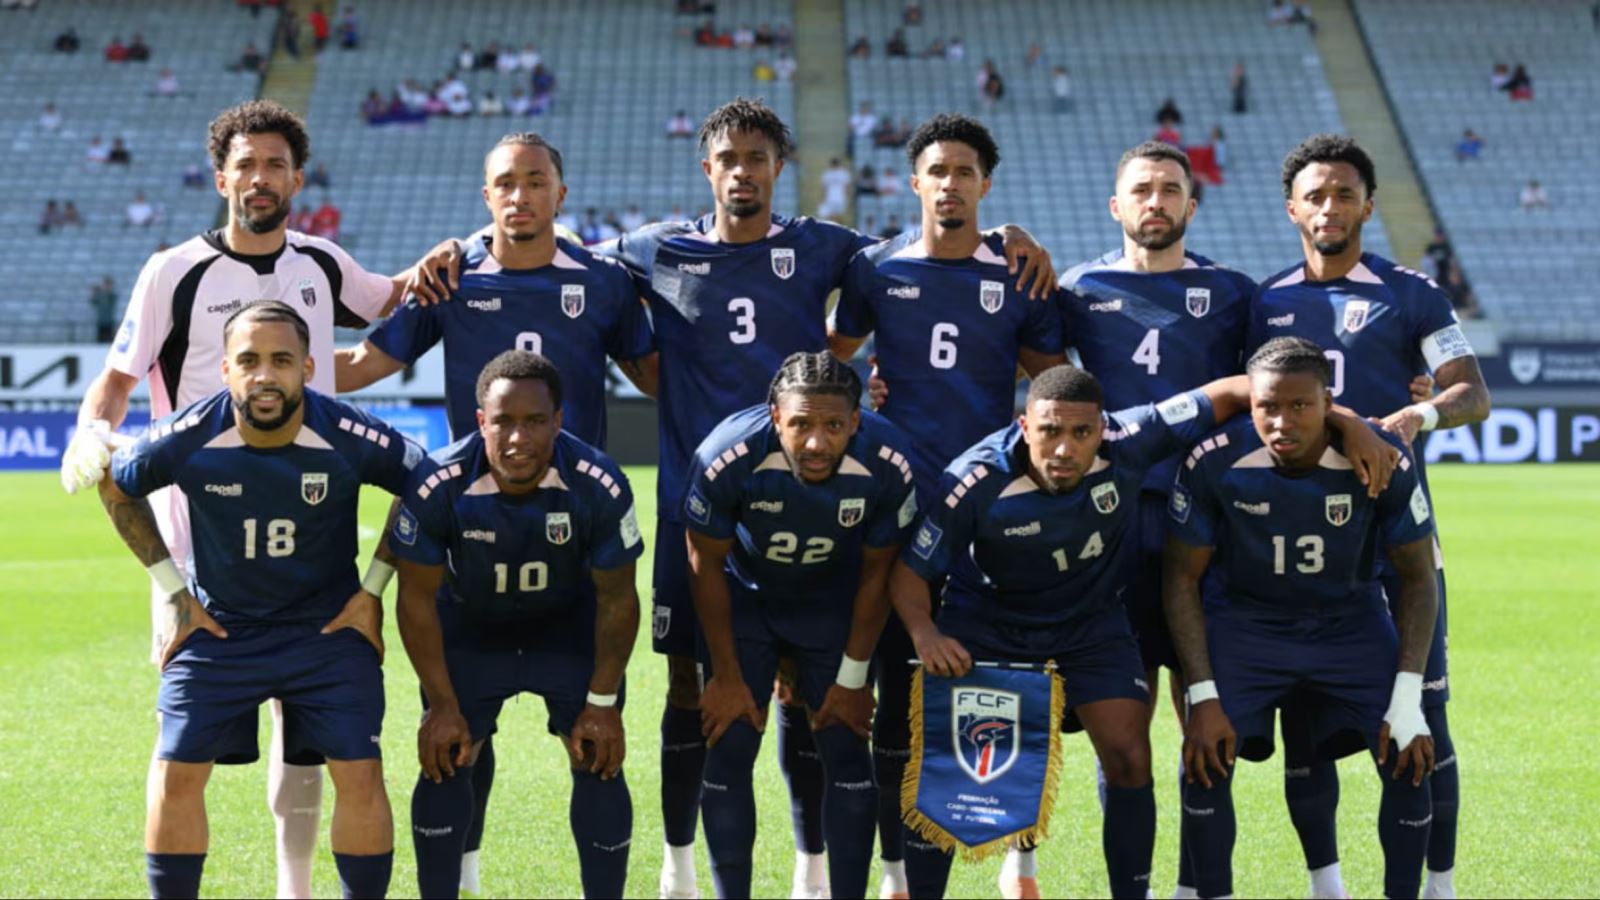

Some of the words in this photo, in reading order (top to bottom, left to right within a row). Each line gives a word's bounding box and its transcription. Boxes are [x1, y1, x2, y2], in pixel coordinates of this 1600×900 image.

[727, 297, 756, 344] 3
[929, 322, 959, 369] 6
[1131, 328, 1160, 375] 4
[243, 518, 296, 559] 18
[765, 531, 834, 564] 22
[1051, 530, 1104, 572] 14
[1272, 534, 1325, 575] 13
[494, 561, 548, 593] 10
[957, 690, 1014, 710] FCF
